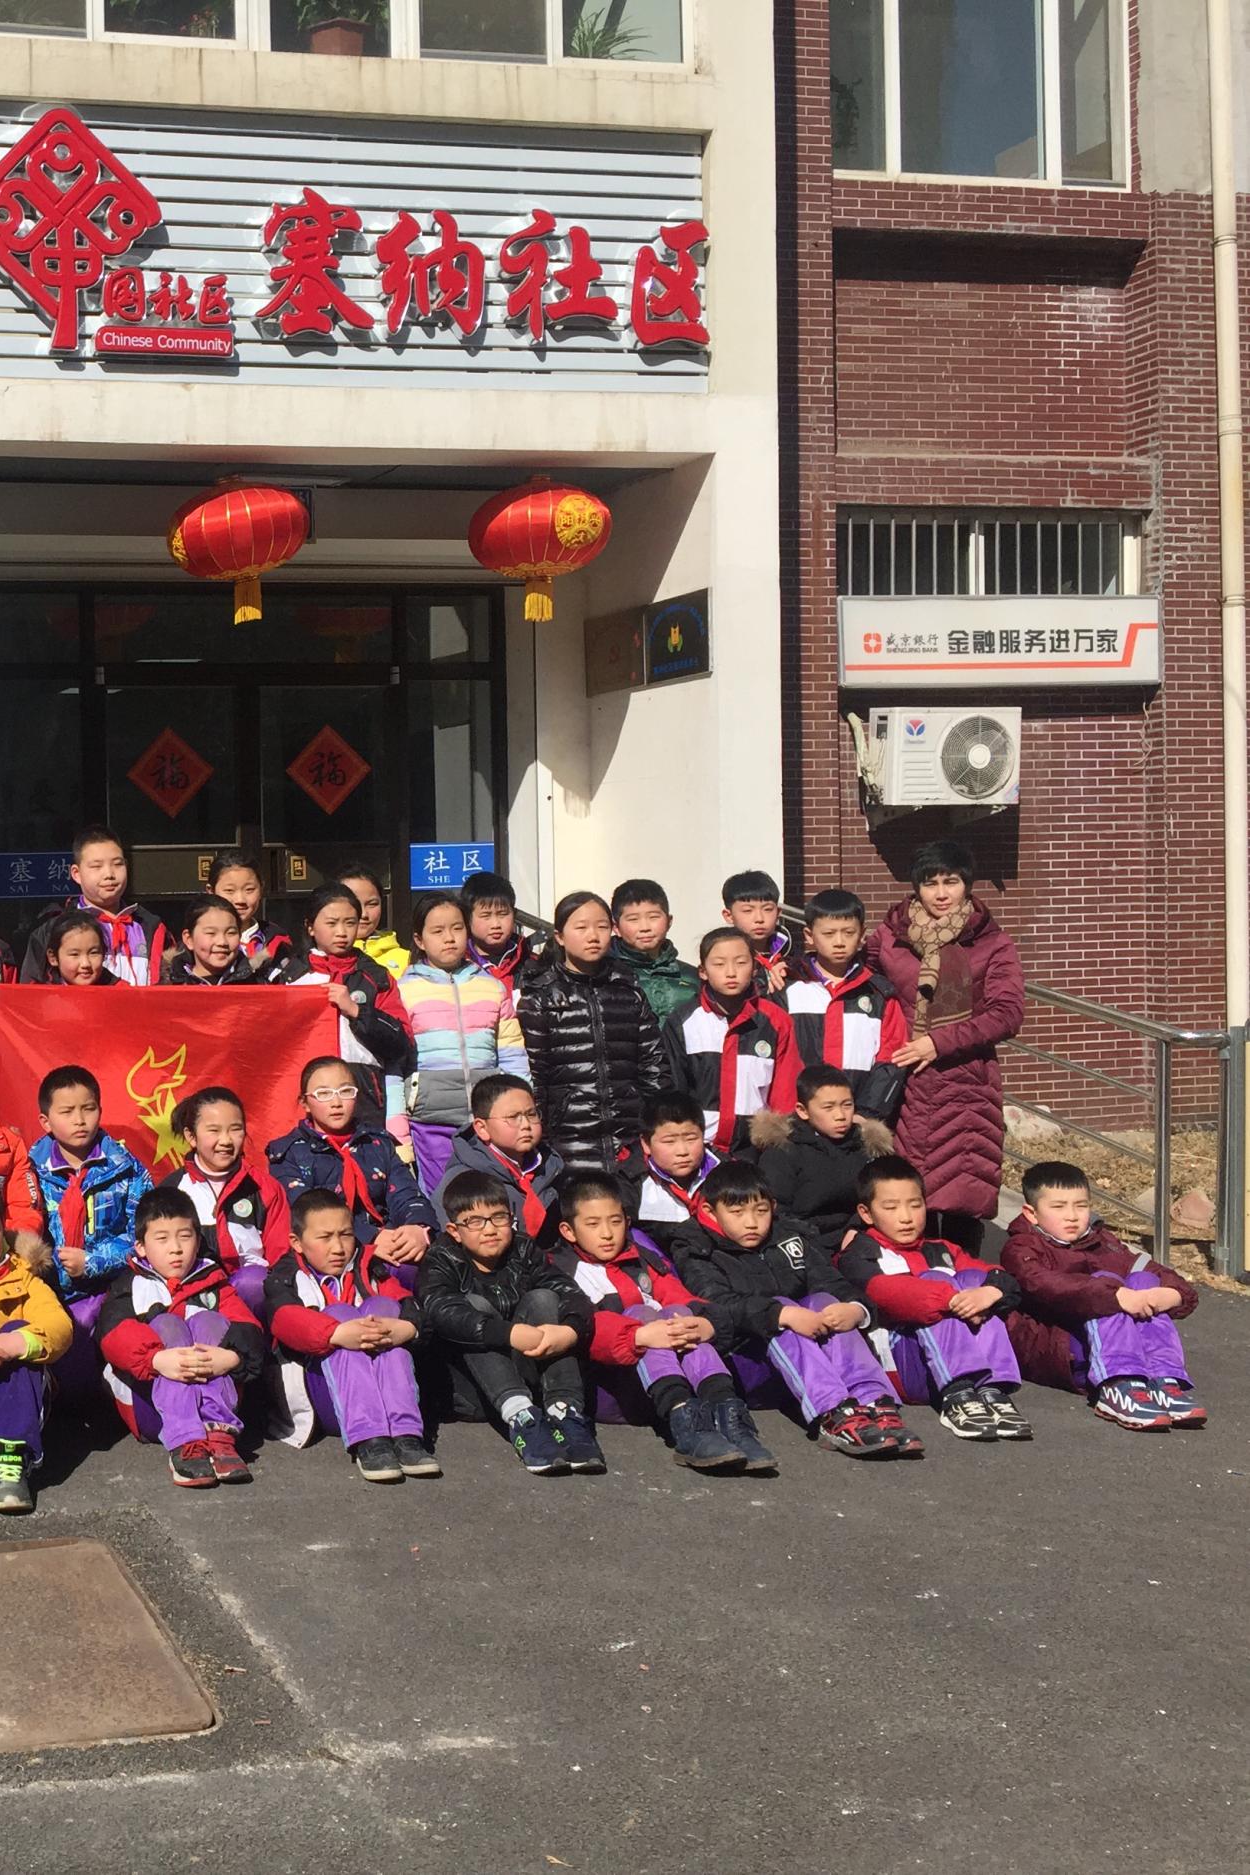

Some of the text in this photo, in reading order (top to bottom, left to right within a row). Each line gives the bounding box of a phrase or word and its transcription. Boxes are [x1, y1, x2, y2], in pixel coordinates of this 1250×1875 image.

[256, 187, 710, 346] 塞纳社区
[102, 332, 232, 353] Chinese Community
[948, 628, 1119, 655] 金融服务进万家
[8, 858, 72, 883] 塞纳
[423, 850, 483, 874] 社区
[9, 884, 71, 894] SAI NA
[427, 875, 450, 883] SHE
